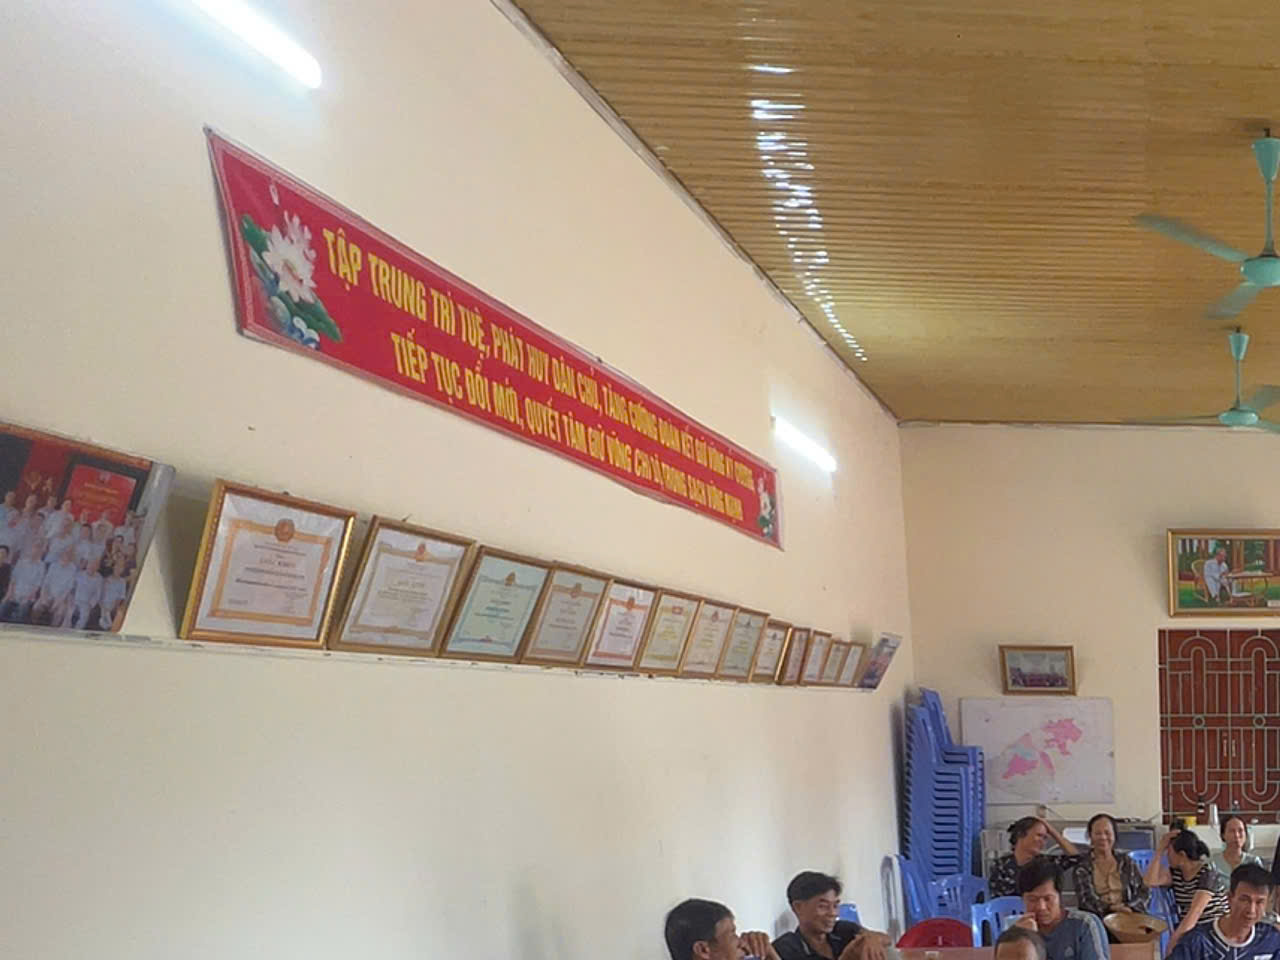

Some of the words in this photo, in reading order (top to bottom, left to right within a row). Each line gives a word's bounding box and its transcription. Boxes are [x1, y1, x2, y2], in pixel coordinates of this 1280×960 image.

[322, 227, 363, 292] TẬP
[367, 252, 427, 322] TRUNG
[429, 287, 456, 337] TRÍ
[457, 303, 491, 361] TUỆ,
[490, 322, 525, 373] PHÁT
[525, 343, 550, 385] HUY
[551, 355, 578, 400] DÂN
[390, 327, 429, 385] TIẾP
[430, 351, 464, 404] TỤC
[464, 352, 492, 413] ĐỔI
[491, 377, 525, 431] MỚI,
[524, 396, 562, 444] QUYẾT
